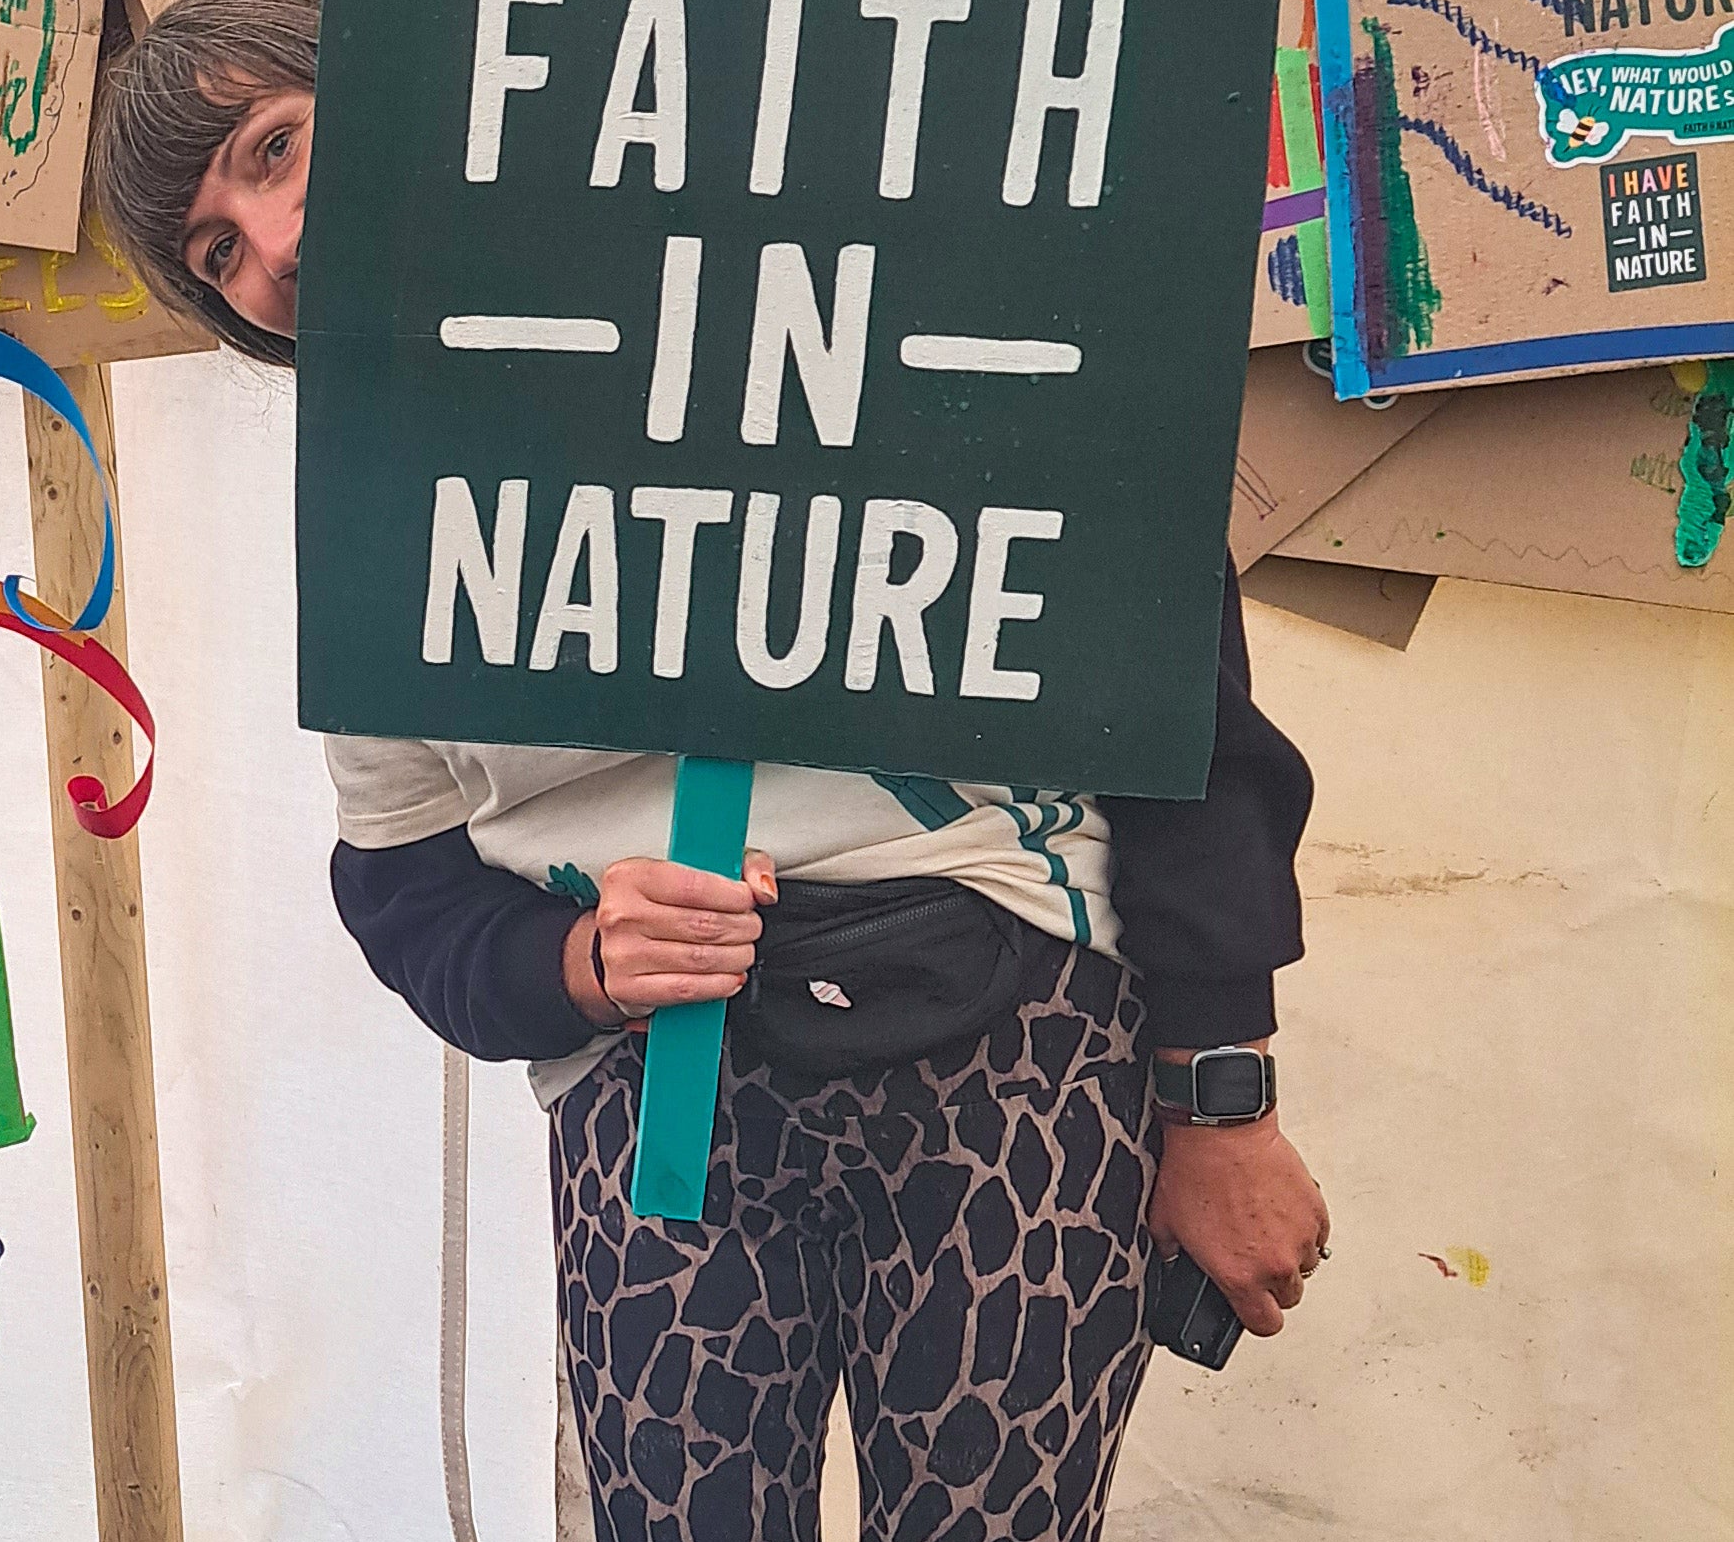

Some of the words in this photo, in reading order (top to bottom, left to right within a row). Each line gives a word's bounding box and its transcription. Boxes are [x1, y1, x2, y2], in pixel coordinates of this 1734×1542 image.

[1611, 66, 1663, 85] WHAT
[1668, 60, 1733, 85] WOULD
[1609, 84, 1720, 116] NATURE
[1608, 173, 1616, 198] I
[1623, 162, 1689, 196] HAVE
[1611, 191, 1692, 227] FAITH
[1615, 247, 1697, 281] NATURE
[421, 475, 1066, 703] NATURE
